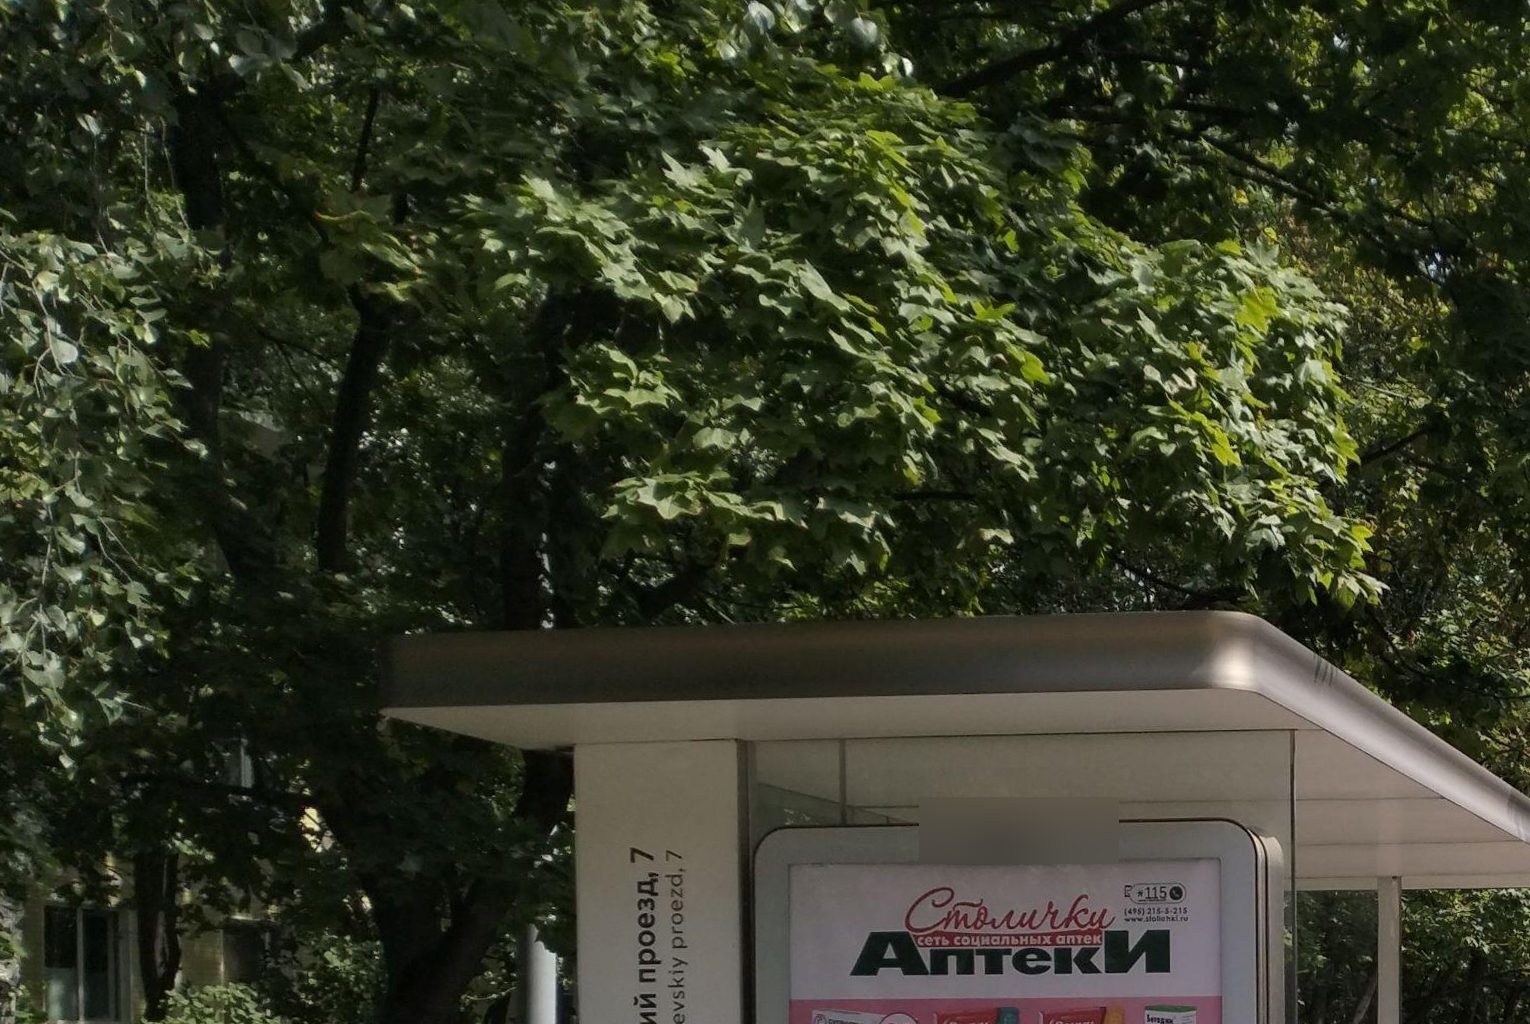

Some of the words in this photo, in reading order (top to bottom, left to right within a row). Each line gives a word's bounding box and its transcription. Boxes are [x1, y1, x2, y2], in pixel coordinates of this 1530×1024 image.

[630, 847, 654, 863] 7
[665, 850, 682, 861] 7
[665, 868, 688, 949] proezd,
[905, 886, 1116, 934] Столички
[637, 872, 662, 983] проезд,
[917, 935, 949, 946] сеть
[954, 934, 1051, 947] социальных
[1056, 934, 1102, 945] аптек
